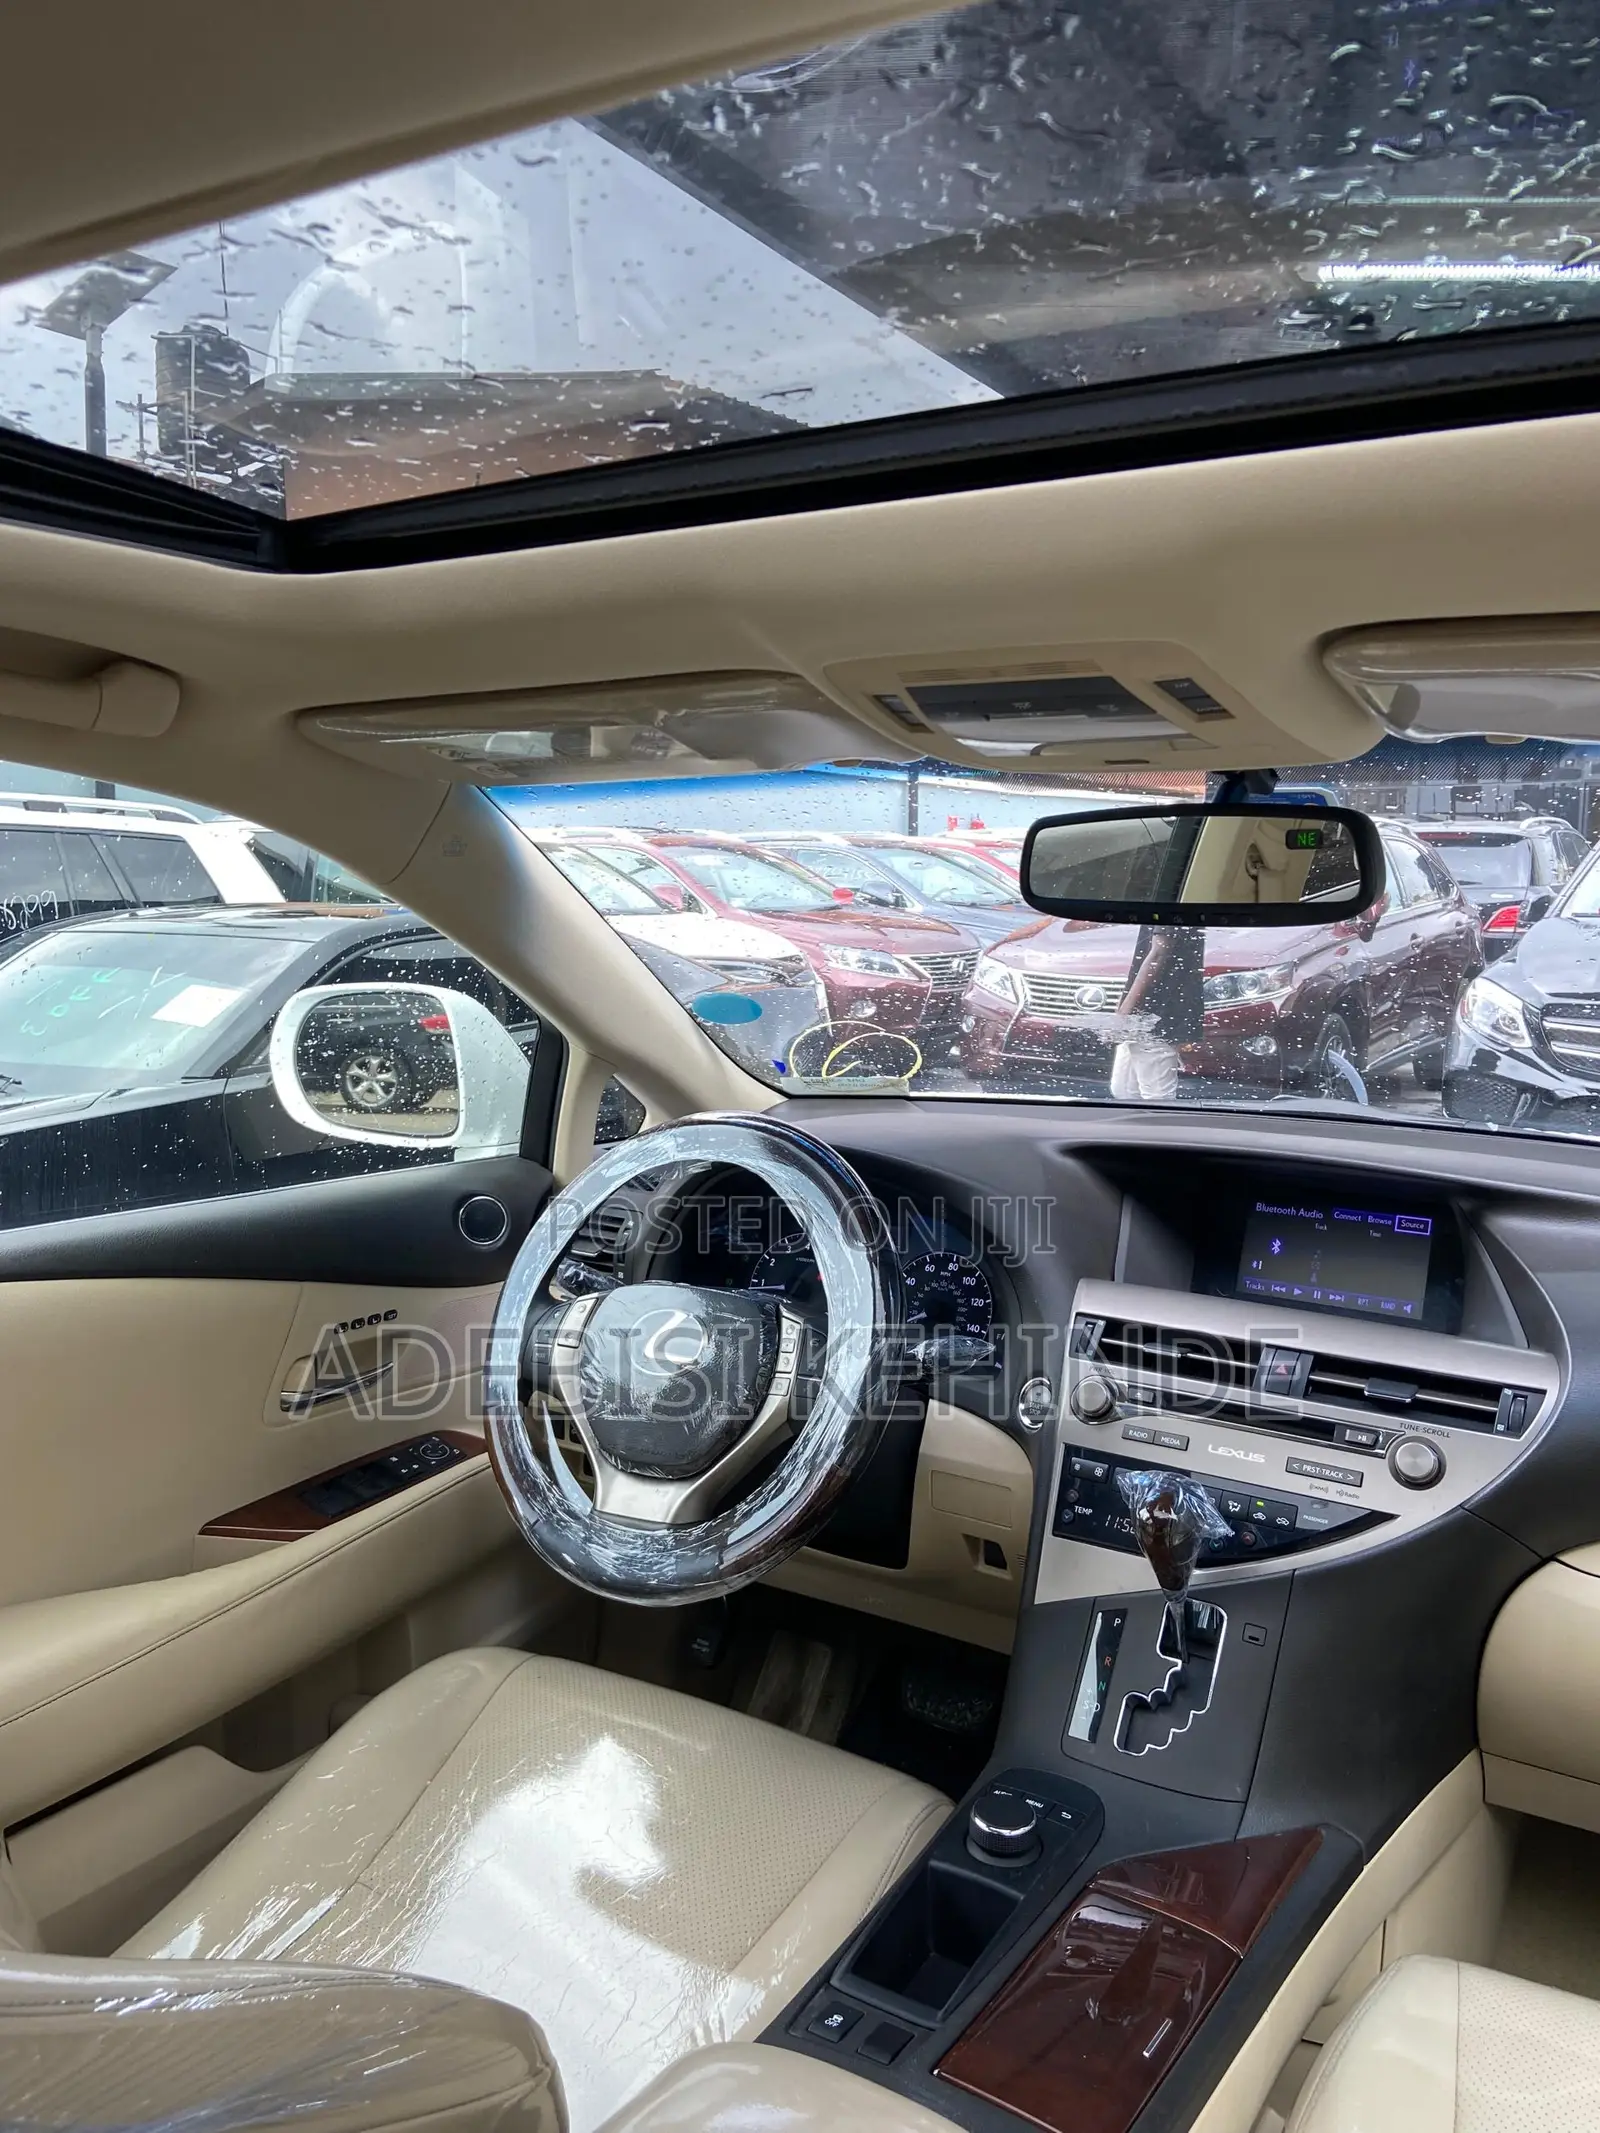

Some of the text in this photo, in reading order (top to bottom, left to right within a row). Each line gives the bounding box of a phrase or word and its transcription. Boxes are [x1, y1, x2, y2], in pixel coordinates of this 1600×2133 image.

[1297, 832, 1316, 846] NE
[1255, 1202, 1324, 1220] Bluetooth Audio
[1334, 1211, 1362, 1222] Connect
[1367, 1215, 1393, 1226] Browse
[1400, 1219, 1425, 1230] Source
[786, 1245, 792, 1253] 3
[769, 1258, 776, 1267] 2
[948, 1262, 959, 1272] 80
[924, 1263, 936, 1273] 60
[905, 1277, 916, 1286] 40
[962, 1276, 977, 1286] 100
[1245, 1280, 1265, 1291] Tracks
[971, 1298, 984, 1307] 120
[966, 1323, 980, 1333] 140
[1128, 1430, 1148, 1440] RADIO
[1160, 1436, 1181, 1446] MEDIA
[1207, 1444, 1266, 1464] LEXUS
[1074, 1505, 1093, 1515] TEMP
[1113, 1617, 1121, 1627] P
[1104, 1656, 1112, 1667] R
[1098, 1681, 1106, 1691] N
[1025, 1798, 1044, 1808] MENU
